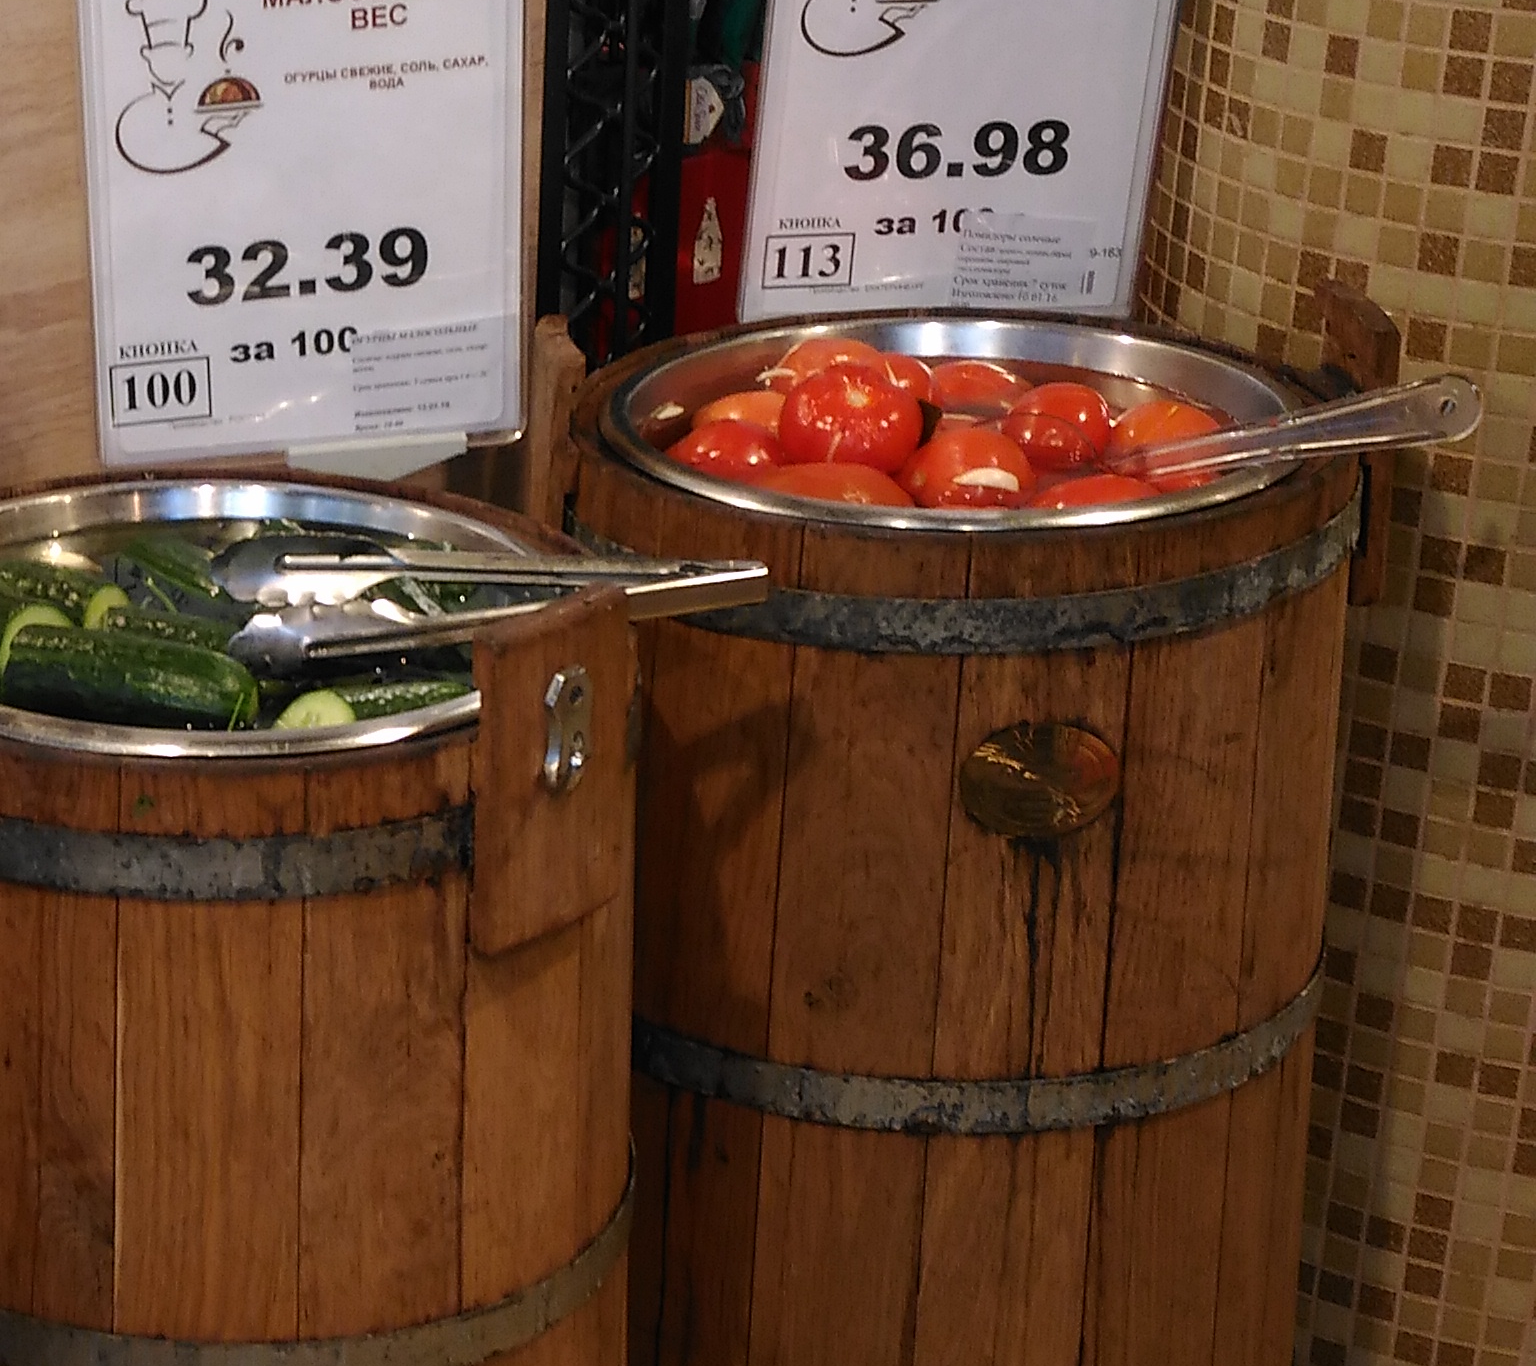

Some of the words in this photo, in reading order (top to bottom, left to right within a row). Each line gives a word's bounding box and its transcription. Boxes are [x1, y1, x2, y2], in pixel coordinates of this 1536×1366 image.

[350, 4, 408, 32] ВЕС
[284, 68, 337, 85] ОГУРЦЫ
[369, 77, 405, 91] ВОДА
[844, 119, 1070, 182] 36.98
[779, 217, 841, 230] КНОПКА
[874, 216, 916, 235] за
[186, 226, 429, 307] 32.39
[772, 244, 841, 278] 113
[119, 339, 198, 359] КНОПКА
[230, 341, 275, 364] за
[123, 369, 197, 411] 100
